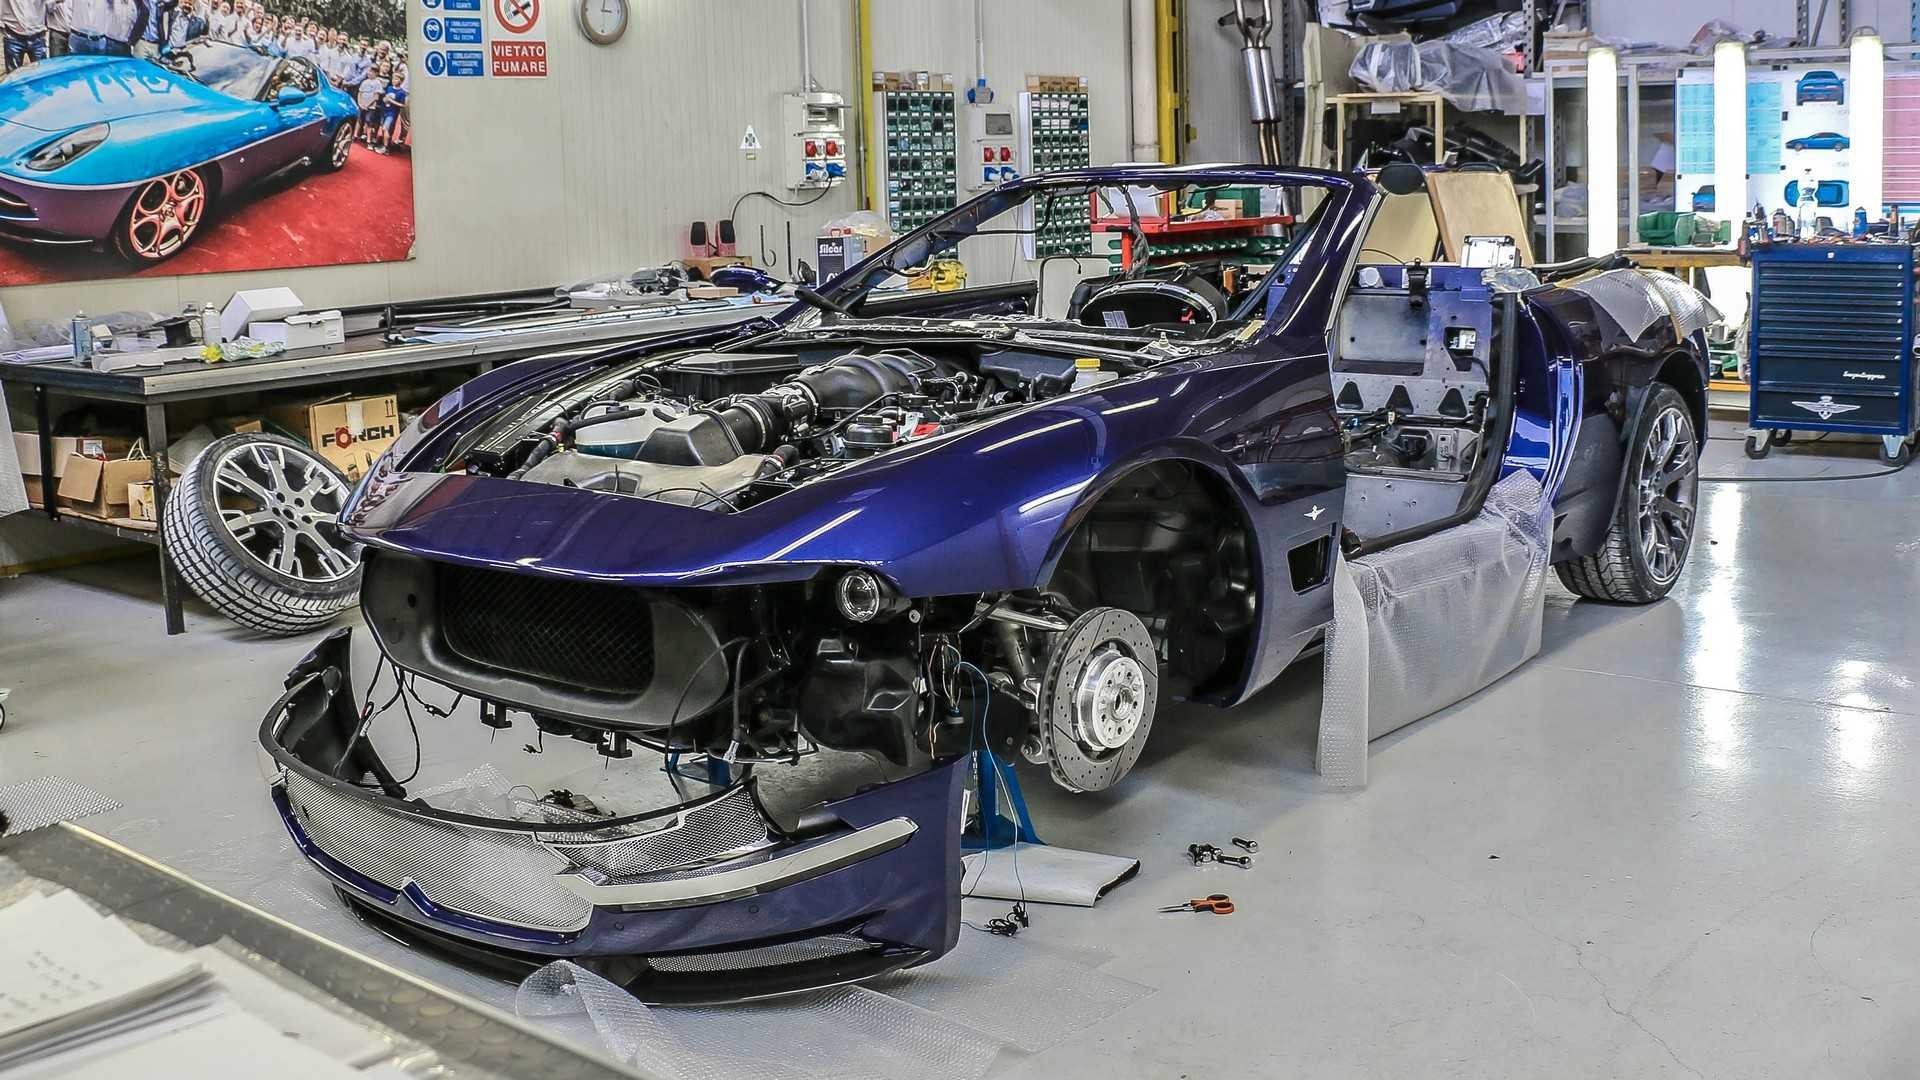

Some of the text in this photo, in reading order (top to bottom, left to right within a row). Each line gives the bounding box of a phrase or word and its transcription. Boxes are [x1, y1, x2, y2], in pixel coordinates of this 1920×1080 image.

[493, 45, 545, 57] VIETATO
[493, 61, 546, 73] FUMARE
[819, 243, 843, 254] Silcar
